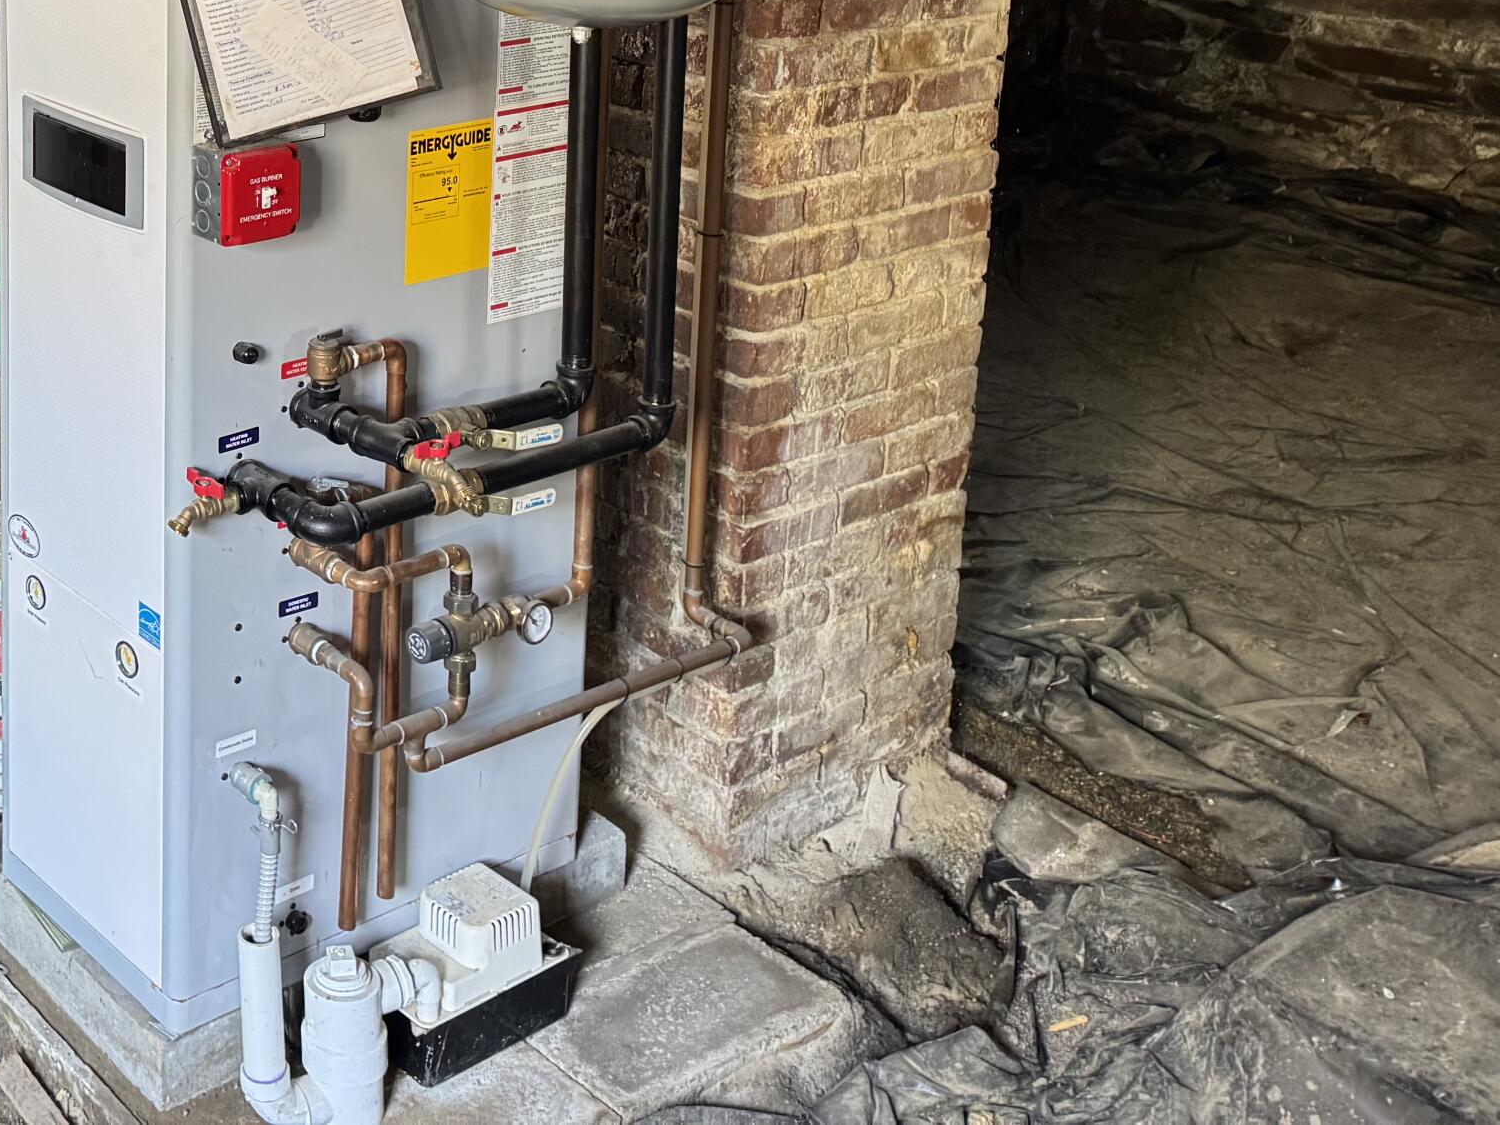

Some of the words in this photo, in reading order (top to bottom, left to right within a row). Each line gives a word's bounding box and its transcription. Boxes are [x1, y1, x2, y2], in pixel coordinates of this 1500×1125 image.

[411, 127, 491, 157] ENERGYGUIDE
[262, 174, 283, 183] BURNER
[442, 176, 458, 186] 95.0
[240, 212, 271, 223] EMERGENCY
[272, 208, 292, 217] SWITCH
